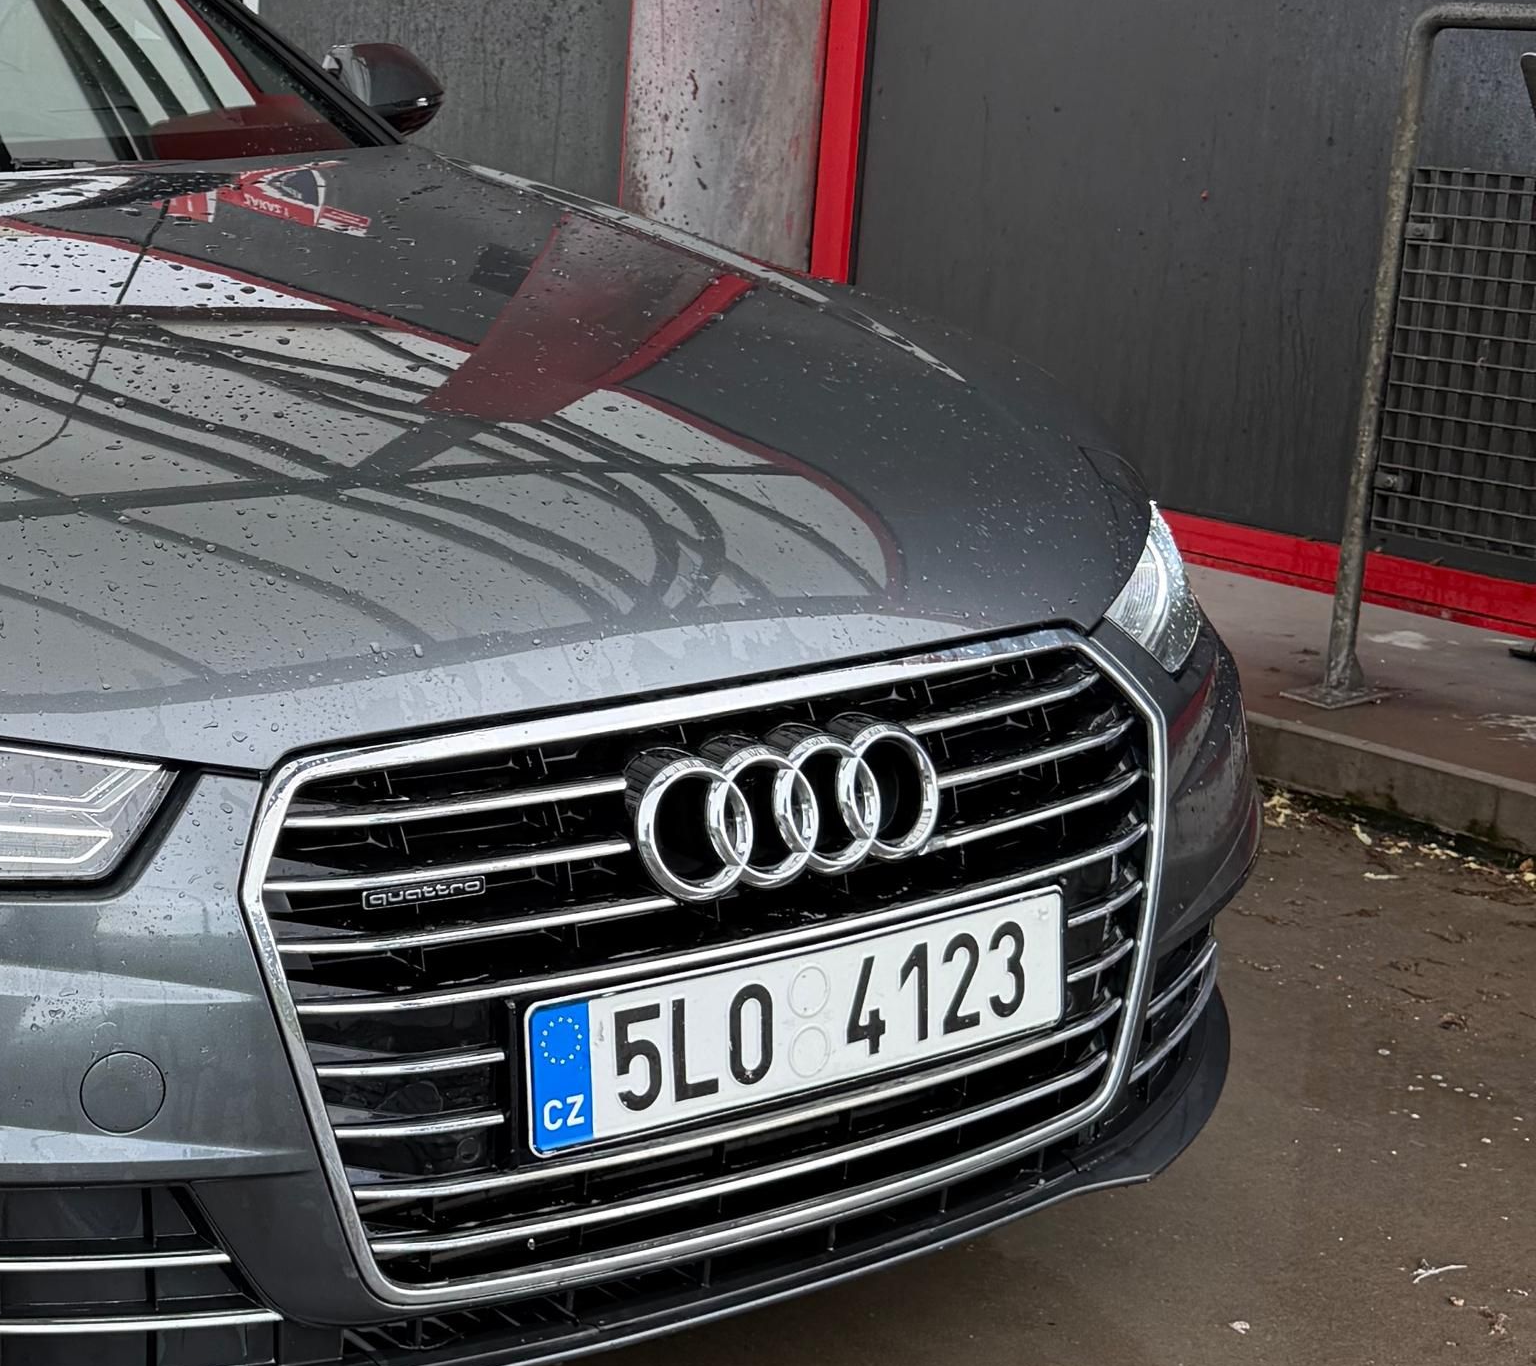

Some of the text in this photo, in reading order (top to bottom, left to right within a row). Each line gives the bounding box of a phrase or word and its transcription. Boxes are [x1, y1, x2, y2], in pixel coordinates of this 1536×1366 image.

[369, 880, 480, 906] quattro
[614, 921, 1026, 1113] 5L0 4123
[542, 1094, 586, 1132] CZ
